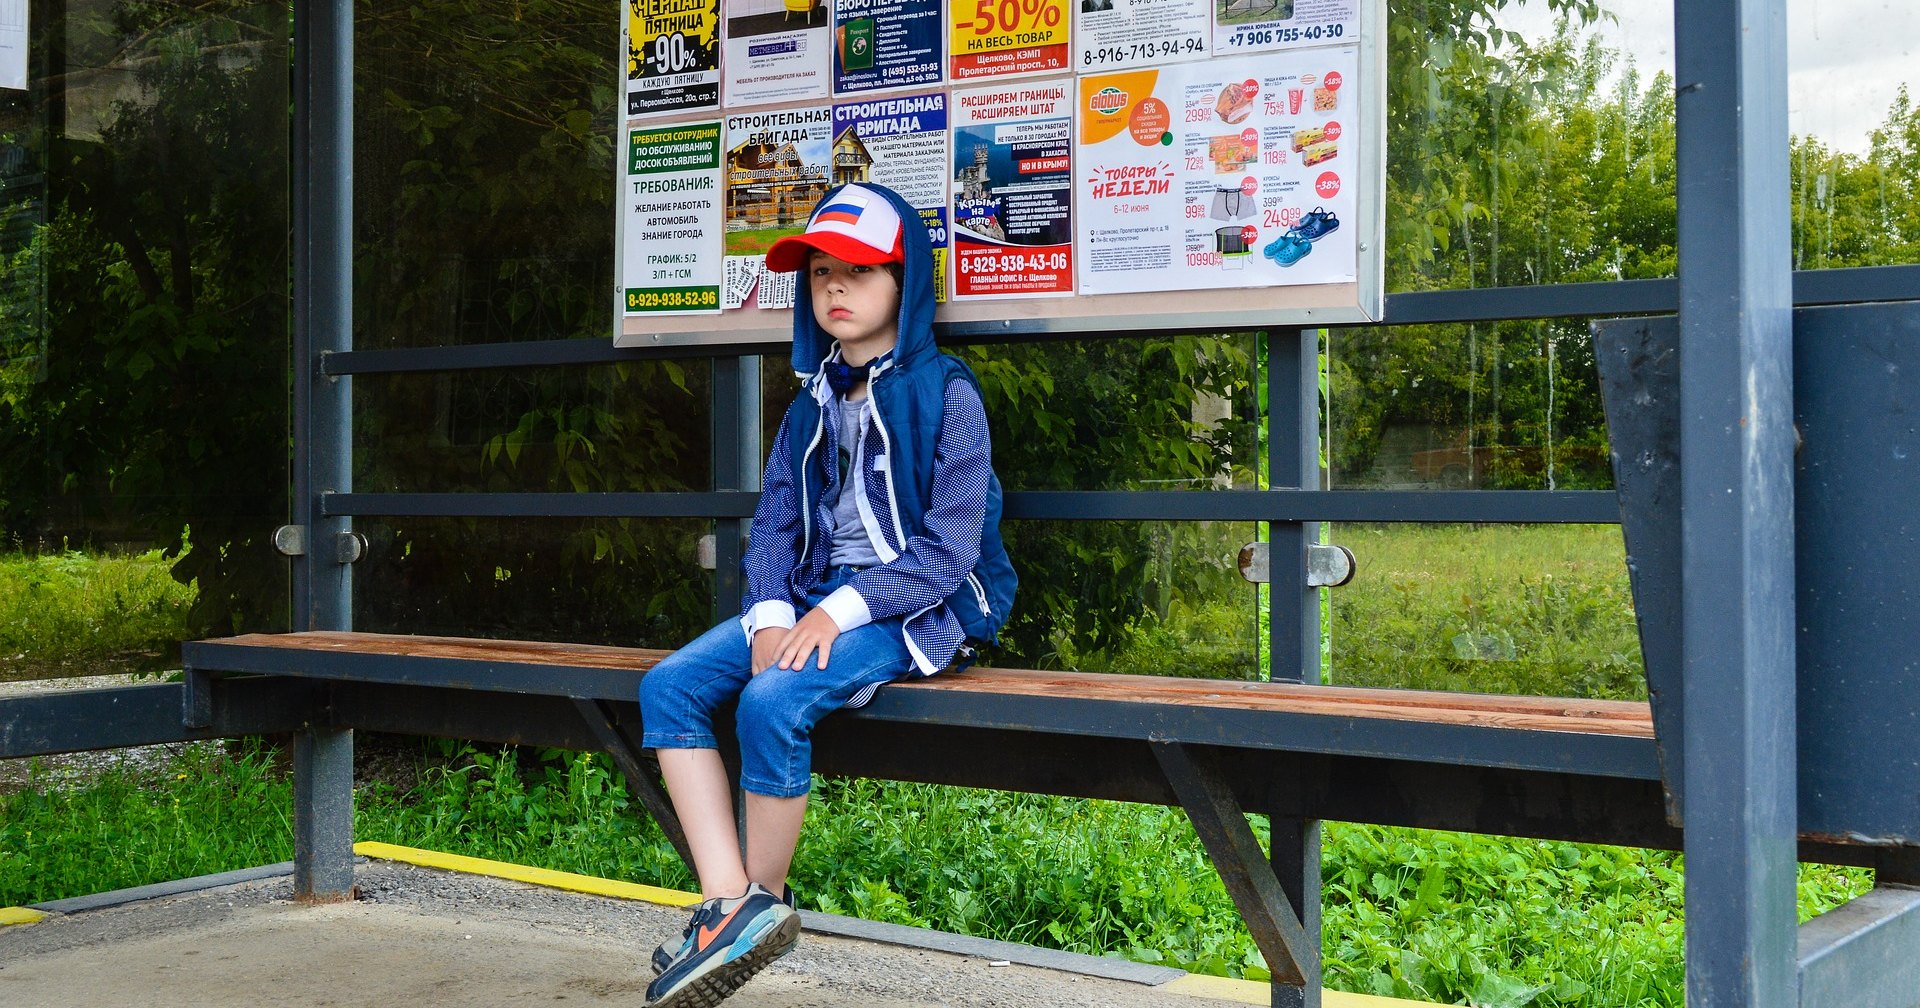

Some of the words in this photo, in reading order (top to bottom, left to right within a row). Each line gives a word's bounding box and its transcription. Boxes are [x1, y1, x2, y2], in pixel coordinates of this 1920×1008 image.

[836, 12, 848, 20] все
[870, 5, 902, 15] заверение
[876, 14, 897, 24] Срочный
[897, 12, 918, 20] перевод
[645, 13, 704, 35] ПЯТНИЦА
[1236, 24, 1254, 32] ИРИНА
[1255, 22, 1280, 30] ЮРЬЕВНА
[968, 38, 983, 50] НА
[986, 36, 1013, 48] ВЕСЬ
[1016, 30, 1053, 45] ТОВАР
[1229, 33, 1244, 46] +7
[1247, 31, 1272, 46] 906
[1275, 23, 1343, 43] 755-40-30
[646, 33, 696, 74] -90%
[977, 53, 1016, 65] Щелково,
[1016, 49, 1041, 60] КЭМП
[1084, 37, 1203, 65] 8-916-713-94-94
[882, 68, 887, 77] 8
[888, 66, 906, 78] (495)
[906, 62, 938, 74] 532-51-93
[959, 63, 1016, 77] Пролетарский
[1016, 61, 1046, 72] просп.,
[1047, 58, 1059, 68] 10,
[642, 76, 671, 89] КАЖДУЮ
[674, 73, 704, 85] ПЯТНИЦУ
[760, 73, 795, 82] ПРОИЗВОДИТЕЛЯ
[847, 81, 873, 90] Щелково,
[630, 101, 639, 110] ул.
[698, 94, 711, 102] стр.
[712, 91, 717, 99] 2
[961, 91, 1018, 108] РАСШИРЯЕМ
[1020, 87, 1066, 102] ГРАНИЦЫ,
[835, 96, 944, 121] СТРОИТЕЛЬНАЯ
[971, 104, 1028, 120] РАСШИРЯЕМ
[1030, 102, 1055, 115] ШТАТ
[1143, 102, 1156, 115] 5%
[728, 109, 831, 130] СТРОИТЕЛЬНАЯ
[856, 116, 921, 136] БРИГАДА
[1044, 121, 1069, 130] РАБОТАЕМ
[632, 132, 672, 144] ТРЕБУЕТСЯ
[673, 128, 718, 140] СОТРУДНИК
[749, 128, 809, 145] БРИГАДА
[1005, 134, 1024, 142] ТОЛЬКО
[1034, 132, 1056, 140] ГОРОДАХ
[1057, 129, 1067, 138] МО
[1148, 126, 1165, 134] товары
[887, 133, 927, 142] СТРОИТЕЛЬНЫХ
[636, 147, 648, 156] ПО
[648, 141, 712, 155] ОБСЛУЖИВАНИЮ
[880, 143, 901, 151] НАШЕГО
[901, 140, 932, 149] МАТЕРИАЛА
[1016, 141, 1055, 150] КРАСНОЯРСКОМ
[757, 152, 775, 163] все
[775, 150, 799, 161] виды
[883, 151, 914, 159] МАТЕРИАЛА
[914, 148, 944, 157] ЗАКАЗЧИКА
[634, 158, 662, 170] ДОСОК
[662, 153, 713, 167] ОБЪЯВЛЕНИЙ
[1021, 161, 1031, 170] НО
[1031, 161, 1037, 169] И
[1037, 160, 1042, 169] В
[1042, 159, 1068, 169] КРЫМУ!
[729, 167, 798, 181] строительных
[799, 163, 829, 179] работ
[633, 176, 714, 194] ТРЕБОВАНИЯ:
[1092, 179, 1170, 200] НЕДЕЛИ
[1316, 180, 1340, 191] -38%
[923, 189, 940, 197] ДОМОВ
[634, 202, 671, 213] ЖЕЛАНИЕ
[672, 200, 711, 210] РАБОТАТЬ
[929, 197, 944, 205] БРУСА
[971, 207, 984, 216] на
[1113, 204, 1129, 214] 6-12
[1130, 204, 1150, 213] июня
[646, 215, 699, 227] АВТОМОБИЛЬ
[965, 217, 991, 227] карте
[641, 230, 672, 240] ЗНАНИЕ
[673, 229, 703, 239] ГОРОДА
[1099, 229, 1119, 237] Щелково,
[1119, 226, 1149, 235] Пролетарский
[1109, 235, 1139, 244] круглосуточно
[647, 254, 683, 264] ГРАФИК:
[684, 253, 697, 263] 5/2
[961, 253, 1067, 274] 8-929-938-43-06
[652, 270, 667, 279] З/П
[668, 271, 673, 279] +
[674, 269, 692, 279] ГСМ
[970, 273, 999, 284] ГЛАВНЫЙ
[999, 274, 1018, 283] ОФИС
[1028, 273, 1057, 282] Щелково
[628, 291, 716, 307] 8-929-938-52-96
